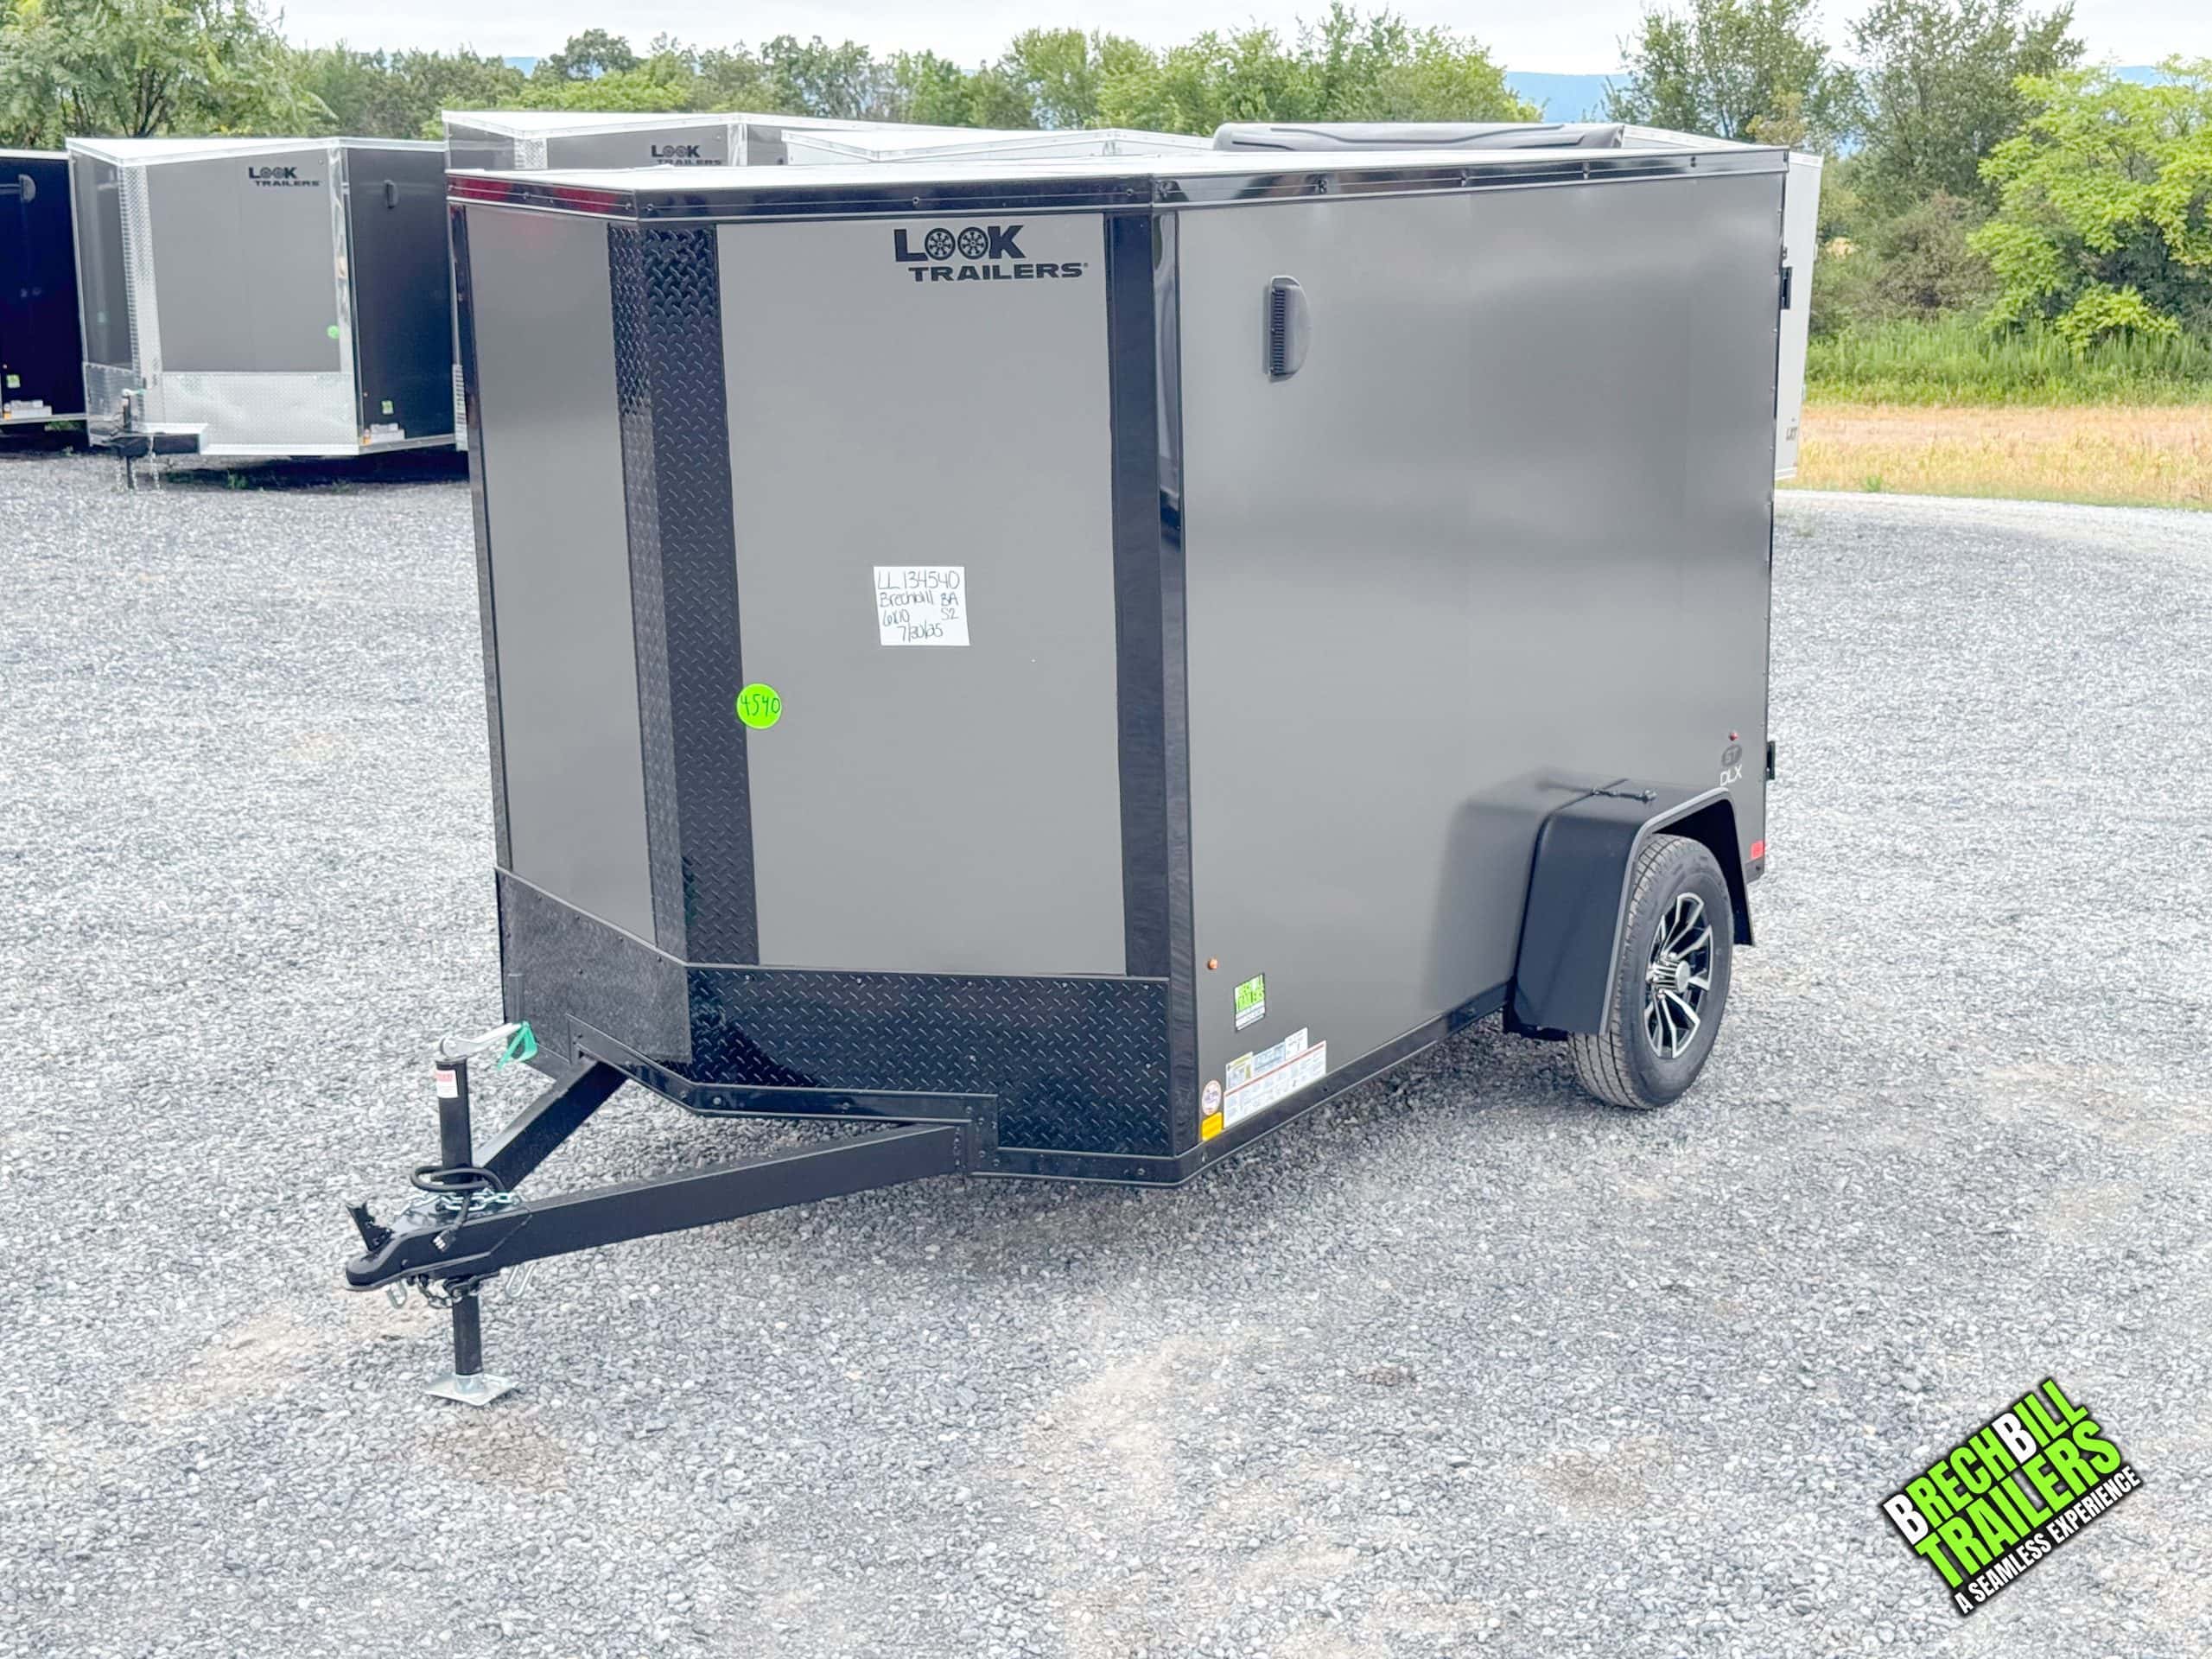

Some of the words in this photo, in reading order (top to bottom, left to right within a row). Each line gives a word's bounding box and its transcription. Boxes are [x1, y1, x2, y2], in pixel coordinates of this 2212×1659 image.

[651, 144, 700, 158] LOOK
[248, 166, 297, 179] LOOK
[893, 225, 1027, 262] LOOK
[908, 262, 1084, 282] TRAILERS
[741, 693, 781, 717] 4540
[1719, 764, 1743, 786] DLX
